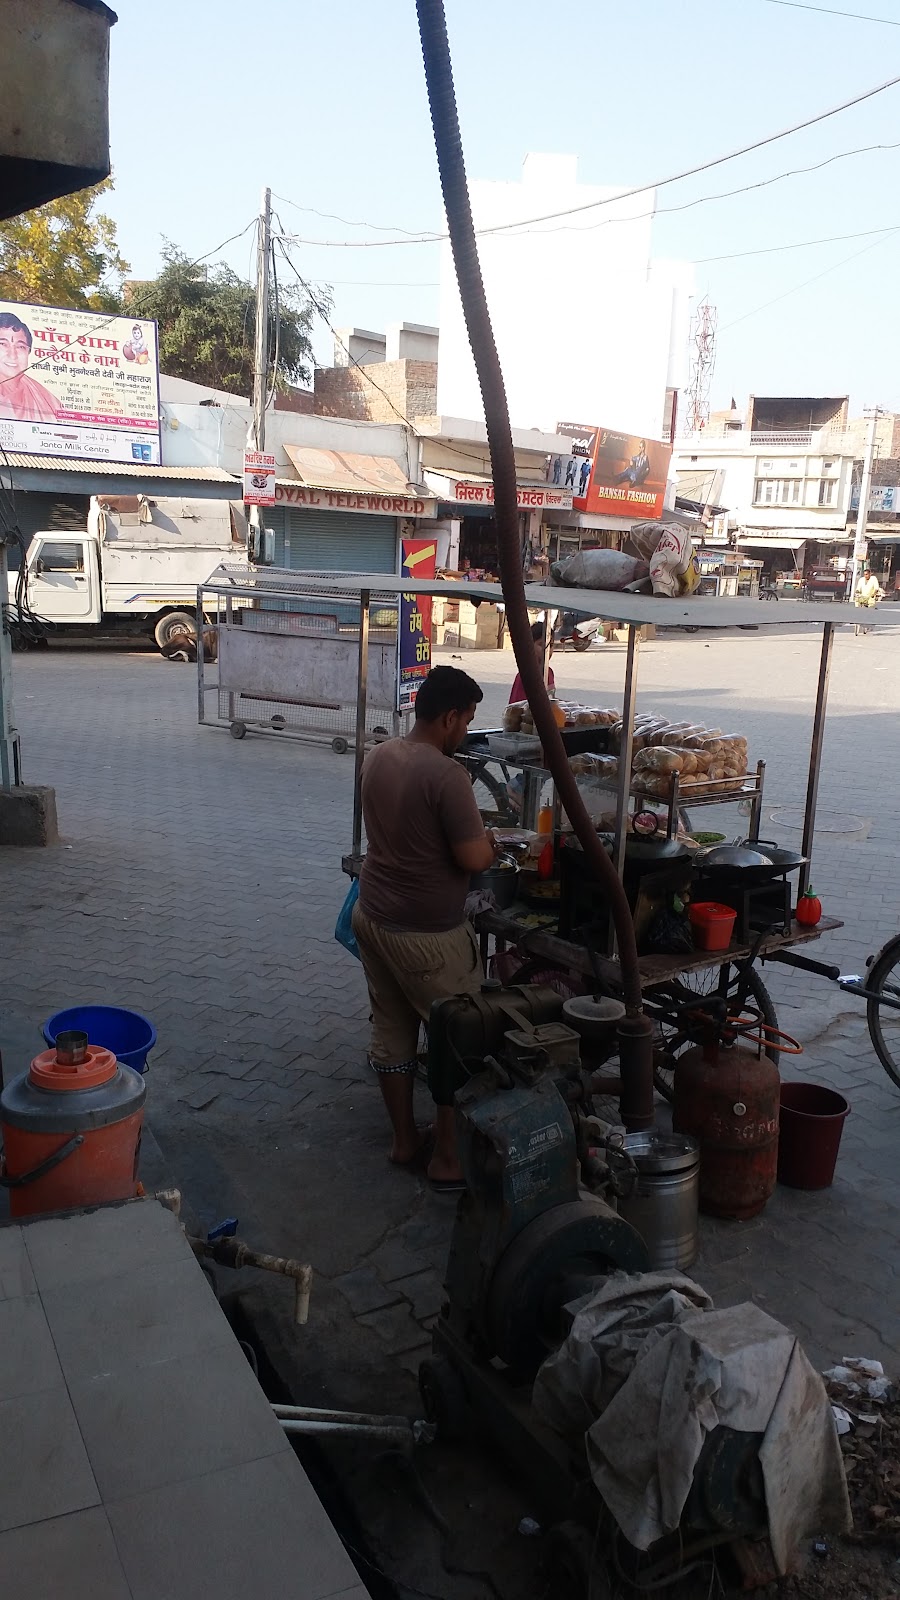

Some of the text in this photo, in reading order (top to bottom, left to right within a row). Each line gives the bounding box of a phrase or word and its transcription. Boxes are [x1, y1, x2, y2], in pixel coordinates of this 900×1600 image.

[33, 327, 120, 352] पाँच शाम
[34, 344, 120, 369] कन्हैया के नाम
[52, 364, 68, 376] सुश्री
[102, 368, 114, 379] देवी
[115, 372, 125, 381] जी
[126, 374, 152, 384] महाराज
[40, 440, 63, 450] Janta
[64, 442, 82, 452] Milk
[83, 444, 110, 454] Centre
[275, 487, 425, 515] OYAL TELEWORLD
[598, 486, 657, 504] BANSAL FASHION
